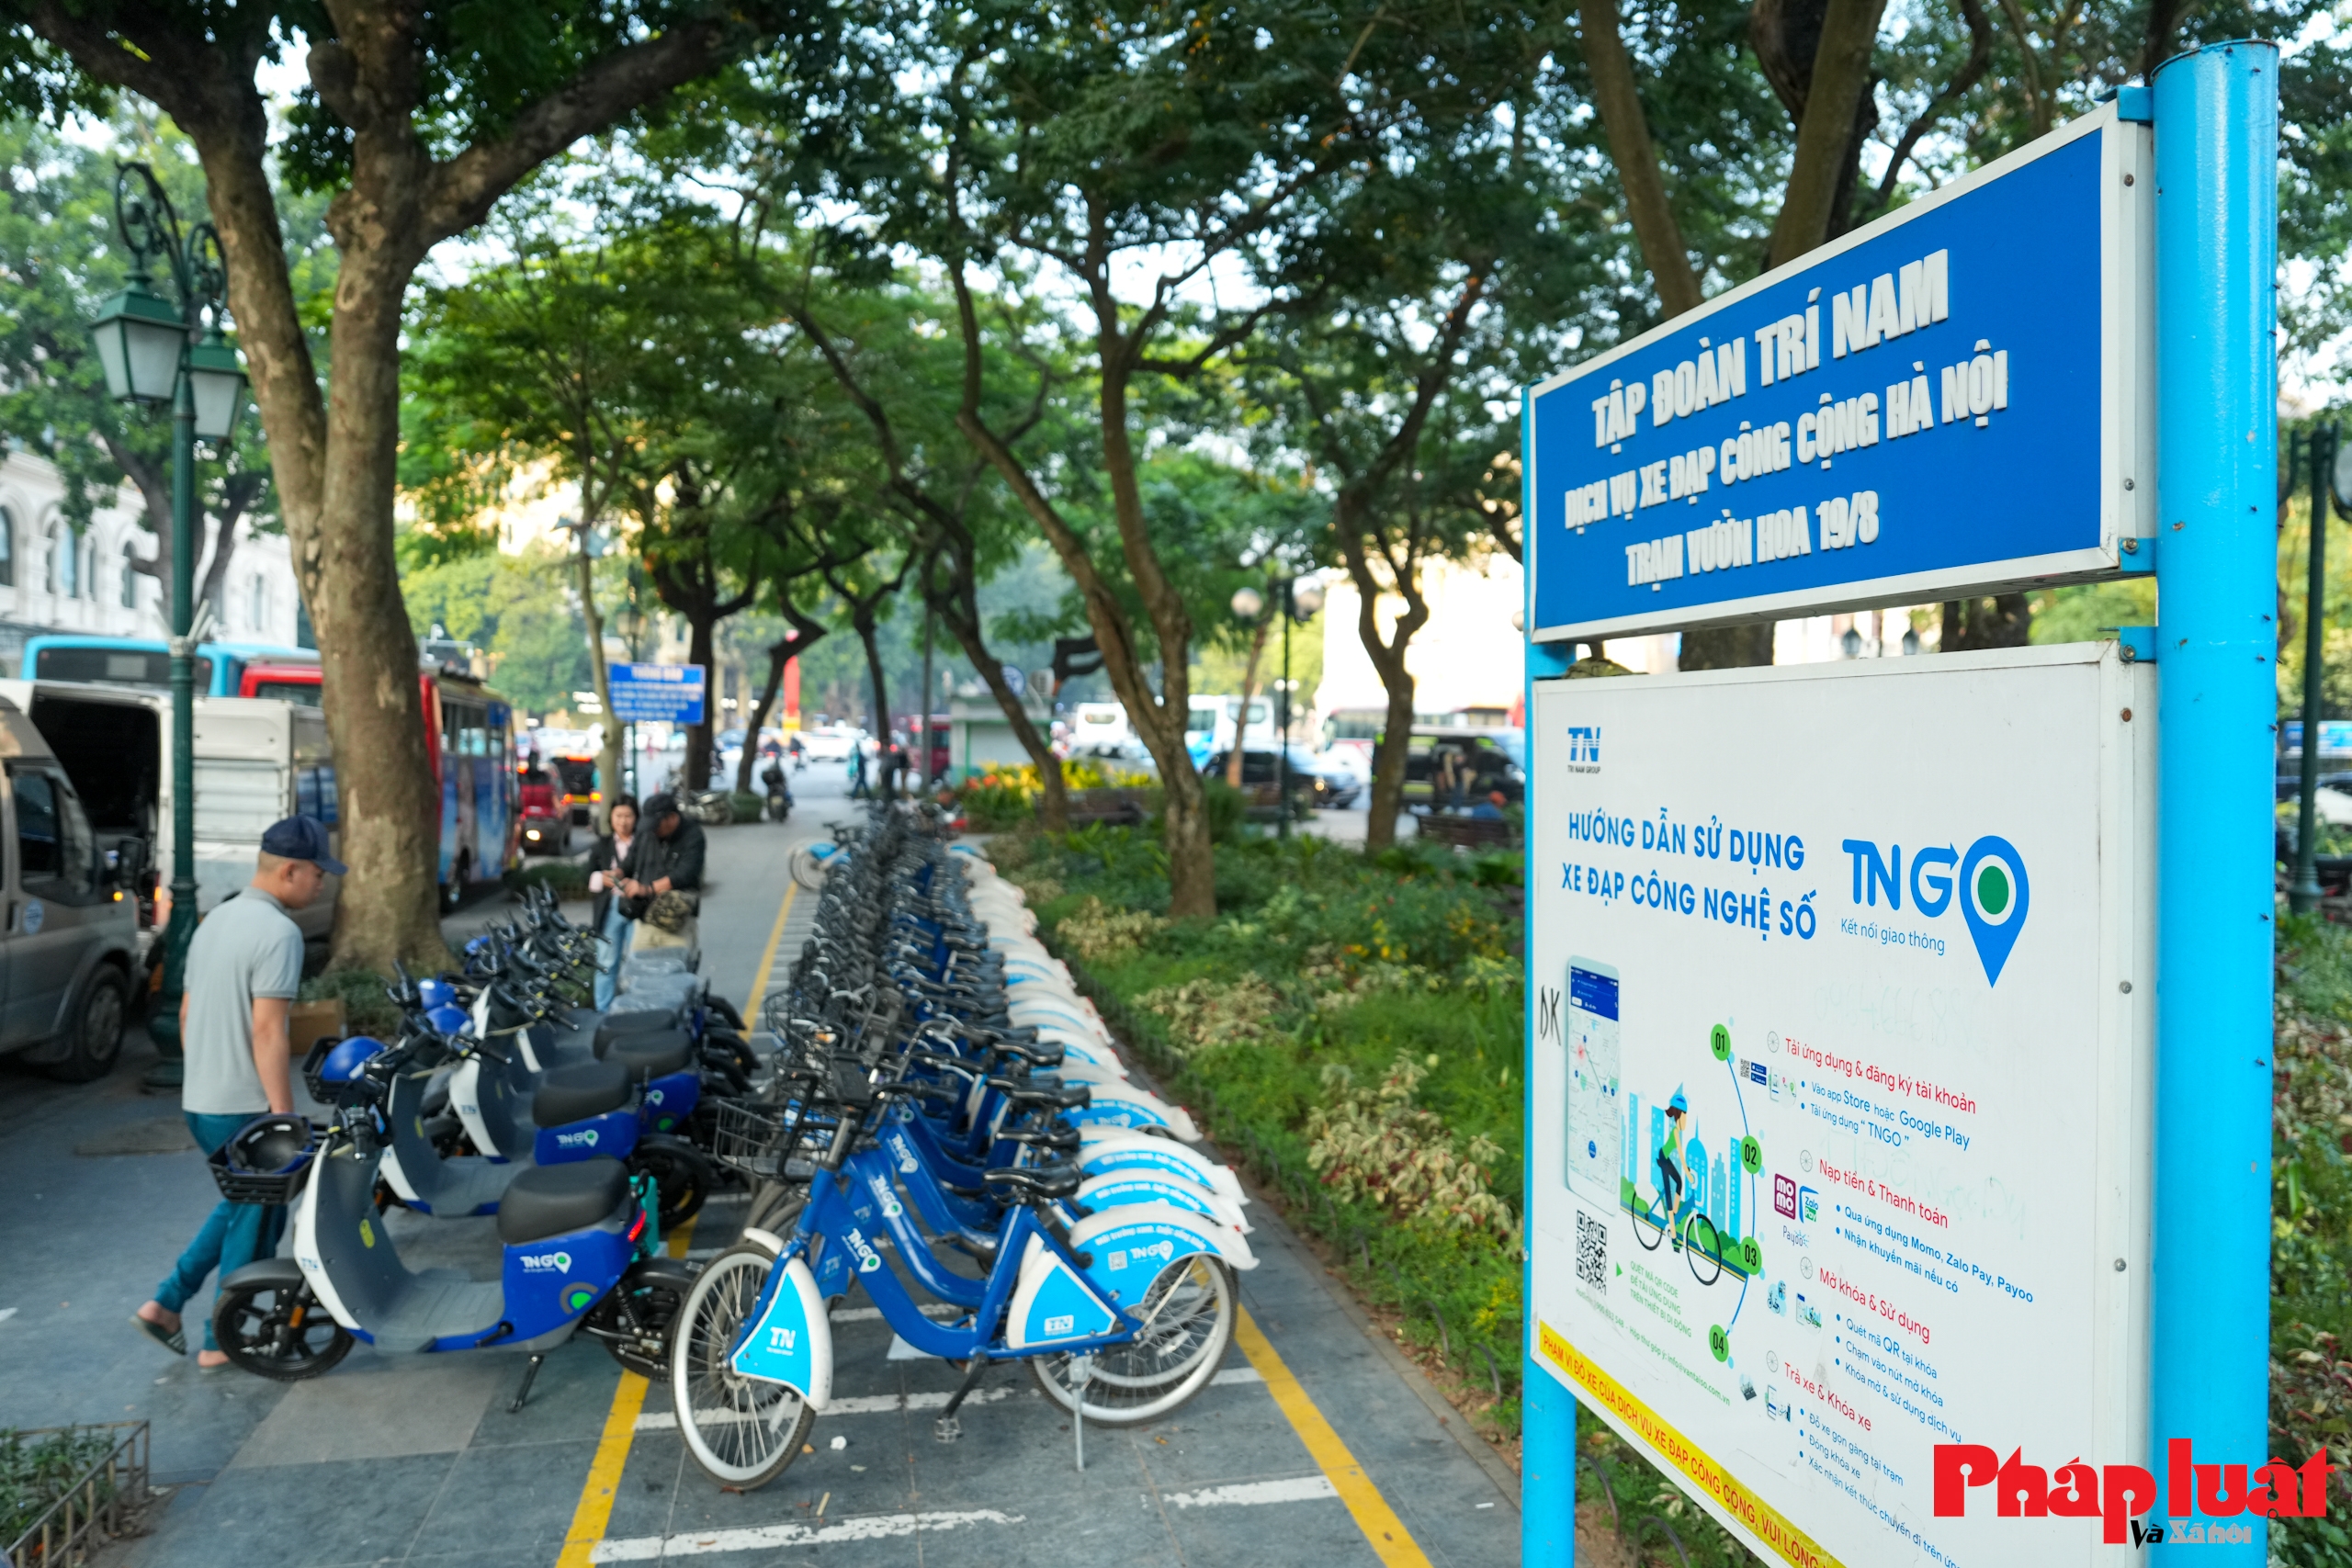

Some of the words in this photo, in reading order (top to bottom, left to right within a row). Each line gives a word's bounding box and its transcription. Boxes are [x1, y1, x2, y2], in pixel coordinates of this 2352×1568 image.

[1591, 378, 1646, 455] TẬP
[1652, 337, 1747, 427] ĐOÀN
[1755, 287, 1822, 387] TRÍ
[1832, 248, 1949, 359] NAM
[1565, 479, 1608, 535] DỊCH
[1609, 469, 1636, 521] VỤ
[1639, 459, 1668, 508] XE
[1669, 446, 1716, 504] ĐẠP
[1720, 420, 1791, 486] CÔNG
[1797, 392, 1879, 469] CỘNG
[1886, 360, 1934, 440] HÀ
[1941, 338, 2008, 427] NỘI
[1625, 534, 1683, 592] TRẠM
[1686, 508, 1752, 575] VƯỜN
[1757, 505, 1812, 563] HOA
[1815, 490, 1879, 551] 19/8
[1567, 727, 1600, 761] TN
[1569, 807, 1635, 848] HƯỚNG
[1643, 807, 1685, 854] DẪN
[1693, 815, 1722, 860] SỬ
[1730, 829, 1804, 874] DỤNG
[1562, 862, 1581, 892] XE
[1588, 866, 1624, 907] ĐẠP
[1631, 869, 1695, 915] CÔNG
[1703, 886, 1770, 942] NGHỆ
[1780, 889, 1817, 940] SỐ
[1842, 835, 2030, 988] TNGO
[1841, 918, 1858, 936] Kết
[1860, 921, 1878, 939] nối
[1881, 927, 1905, 944] giao
[1908, 931, 1945, 956] thông
[1715, 1032, 1725, 1052] 01
[1785, 1037, 1800, 1056] Tải
[1802, 1043, 1822, 1067] ứng
[1825, 1051, 1852, 1077] dụng
[1855, 1061, 1863, 1077] &
[1866, 1065, 1895, 1091] đăng
[1898, 1071, 1913, 1096] ký
[1916, 1079, 1931, 1099] tài
[1935, 1085, 1976, 1114] khoản
[1810, 1102, 1821, 1118] Tải
[1822, 1108, 1838, 1126] ứng
[1838, 1113, 1859, 1134] dụng
[1868, 1122, 1902, 1147] TNGO
[1812, 1081, 1826, 1096] Vào
[1827, 1089, 1841, 1102] app
[1843, 1089, 1871, 1111] Store
[1873, 1103, 1894, 1122] hoặc
[1899, 1110, 1941, 1137] Google
[1945, 1125, 1970, 1151] Play
[1745, 1143, 1757, 1166] 02
[1805, 1196, 1818, 1211] Zalo
[1805, 1206, 1816, 1222] Pay
[1819, 1158, 1841, 1185] Nạp
[1843, 1169, 1865, 1192] tiền
[1867, 1179, 1876, 1197] &
[1879, 1183, 1916, 1215] Thanh
[1918, 1202, 1949, 1229] toán
[519, 1251, 571, 1274] TNGO
[1745, 1244, 1757, 1267] 03
[1783, 1225, 1804, 1247] Payoo
[1844, 1228, 1867, 1250] Nhận
[1870, 1240, 1902, 1267] khuyến
[1905, 1256, 1922, 1275] mãi
[1925, 1265, 1943, 1286] nếu
[1945, 1275, 1959, 1293] có
[1845, 1206, 1862, 1224] Qua
[1864, 1213, 1883, 1235] ứng
[1885, 1225, 1908, 1247] dụng
[1911, 1235, 1943, 1263] Momo,
[1946, 1252, 1969, 1273] Zalo
[1972, 1264, 1995, 1288] Pay,
[1997, 1278, 2033, 1303] Payoo
[1630, 1288, 1644, 1304] TRÊN
[1667, 1314, 1673, 1325] DI
[1663, 1281, 1679, 1299] CODE
[1663, 1296, 1680, 1315] DỤNG
[1819, 1268, 1838, 1290] Mở
[1838, 1278, 1866, 1305] khóa
[1869, 1294, 1877, 1311] &
[1880, 1300, 1896, 1322] Sử
[1898, 1312, 1930, 1345] dụng
[770, 1326, 796, 1348] TN
[1713, 1332, 1724, 1354] 04
[1846, 1318, 1867, 1335] Quét
[1869, 1333, 1882, 1347] mã
[1883, 1337, 1900, 1358] QR
[1902, 1348, 1914, 1366] tại
[1915, 1356, 1938, 1379] khóa
[1784, 1361, 1801, 1384] Trả
[1803, 1379, 1815, 1393] xe
[1817, 1384, 1825, 1401] &
[1827, 1390, 1855, 1421] Khóa
[1858, 1413, 1871, 1431] xe
[1845, 1362, 1866, 1383] Khóa
[1867, 1378, 1881, 1393] mở
[1883, 1385, 1889, 1398] &
[1890, 1389, 1902, 1405] sử
[1903, 1399, 1926, 1422] dụng
[1927, 1413, 1948, 1437] dịch
[1950, 1428, 1962, 1444] vụ
[1846, 1340, 1870, 1363] Chạm
[1871, 1357, 1886, 1372] vào
[1888, 1366, 1903, 1383] nút
[1905, 1376, 1919, 1393] mở
[1920, 1383, 1943, 1407] khóa
[1544, 1334, 1564, 1363] PHẠM
[1566, 1351, 1572, 1371] VI
[1587, 1370, 1597, 1391] XE
[1599, 1381, 1616, 1407] CỦA
[1618, 1395, 1637, 1426] DỊCH
[1640, 1413, 1652, 1439] VỤ
[1655, 1425, 1666, 1450] XE
[1668, 1438, 1689, 1465] ĐẠP
[1690, 1458, 1721, 1495] CÔNG
[1723, 1483, 1758, 1529] CỘNG,
[1761, 1513, 1781, 1546] VUI
[1783, 1533, 1818, 1568] LÒNG
[1809, 1413, 1820, 1428] Đỗ
[1821, 1423, 1831, 1436] xe
[1832, 1430, 1848, 1449] gọn
[1849, 1440, 1869, 1464] gàng
[1871, 1456, 1882, 1471] tại
[1883, 1465, 1904, 1486] trạm
[1809, 1434, 1829, 1460] Đóng
[1830, 1450, 1849, 1472] khóa
[1851, 1467, 1860, 1479] xe
[1808, 1455, 1823, 1474] Xác
[1824, 1468, 1843, 1490] nhận
[1844, 1481, 1858, 1500] kết
[1859, 1493, 1878, 1515] thúc
[1879, 1509, 1911, 1539] chuyến
[1912, 1533, 1921, 1547] đi
[1923, 1540, 1942, 1562] trên
